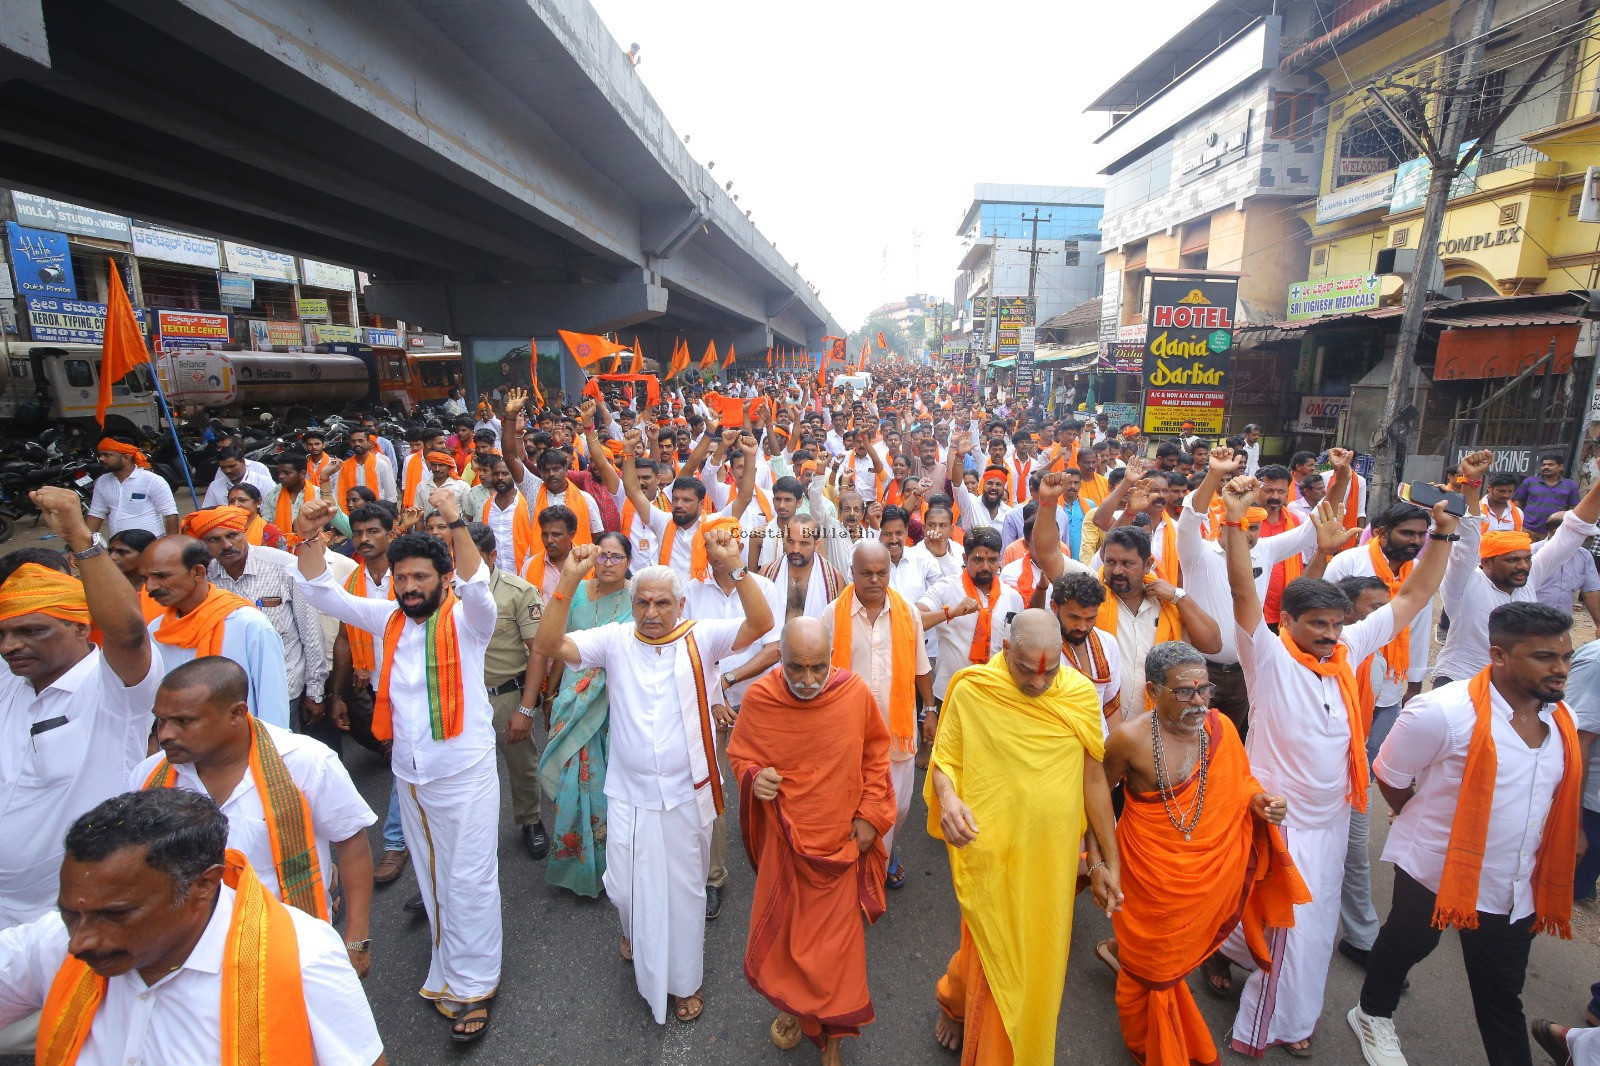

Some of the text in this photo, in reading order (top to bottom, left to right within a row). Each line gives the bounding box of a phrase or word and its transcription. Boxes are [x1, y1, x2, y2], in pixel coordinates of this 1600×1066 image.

[1342, 160, 1387, 173] WELCOME
[17, 204, 55, 219] HOLLA
[58, 212, 94, 226] STUDIO
[100, 219, 127, 231] VIDEO
[1436, 226, 1521, 256] COMPLEX
[23, 282, 71, 293] Quick Photos
[1290, 292, 1375, 314] SRI VIGNESH MEDICALS
[62, 314, 94, 330] TYPING,
[1153, 305, 1232, 329] HOTEL
[162, 324, 227, 335] TEXTILE CENTER
[375, 333, 398, 347] LAXMI
[1113, 349, 1143, 358] Disha
[179, 360, 207, 368] Reliance
[256, 368, 292, 379] Reliance
[1149, 359, 1225, 386] Darbar
